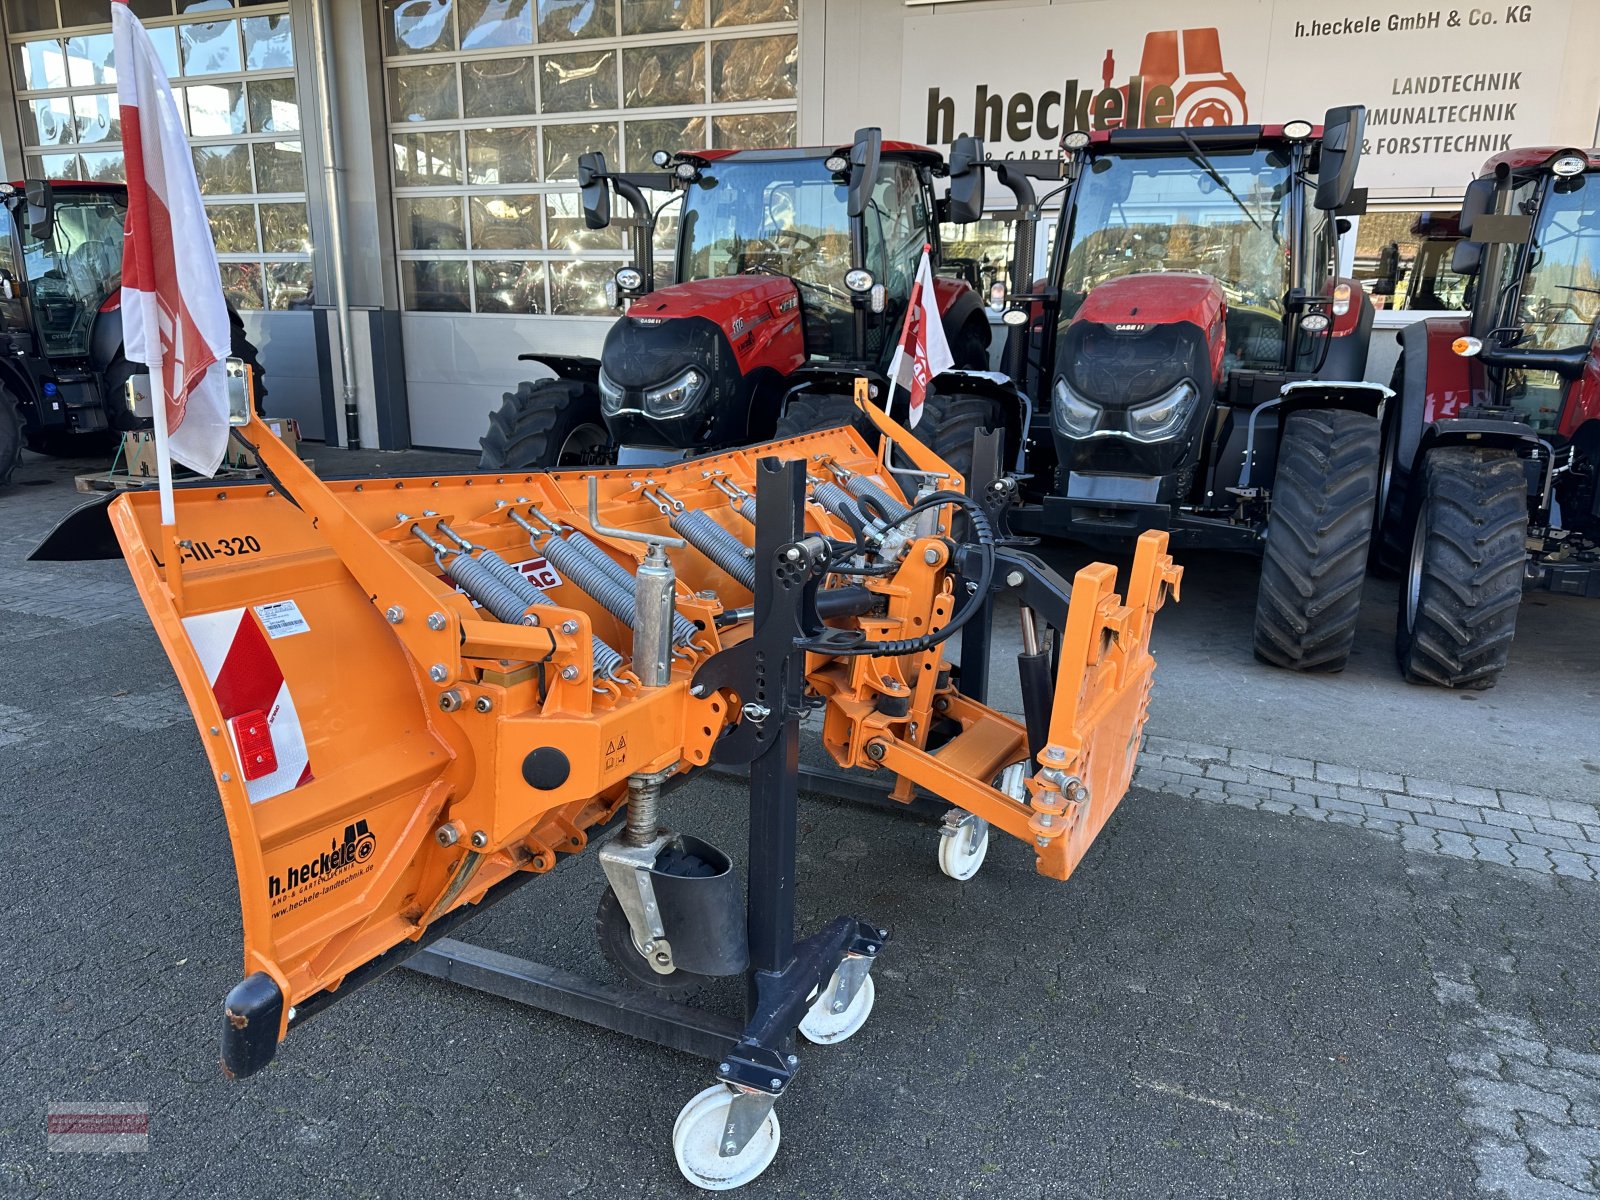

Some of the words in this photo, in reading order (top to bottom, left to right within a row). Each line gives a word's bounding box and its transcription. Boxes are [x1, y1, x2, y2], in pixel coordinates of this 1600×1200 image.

[1294, 16, 1381, 37] h.heckele
[1387, 11, 1441, 31] GmbH
[1446, 10, 1462, 28] &
[1468, 8, 1498, 26] Co.
[1505, 5, 1532, 24] KG
[1392, 72, 1523, 95] LANDTECHNIK
[926, 76, 1175, 145] h.heckele
[1376, 134, 1513, 155] FORSTTECHNIK
[150, 535, 261, 568] L-III-320
[268, 841, 357, 899] h.heckele
